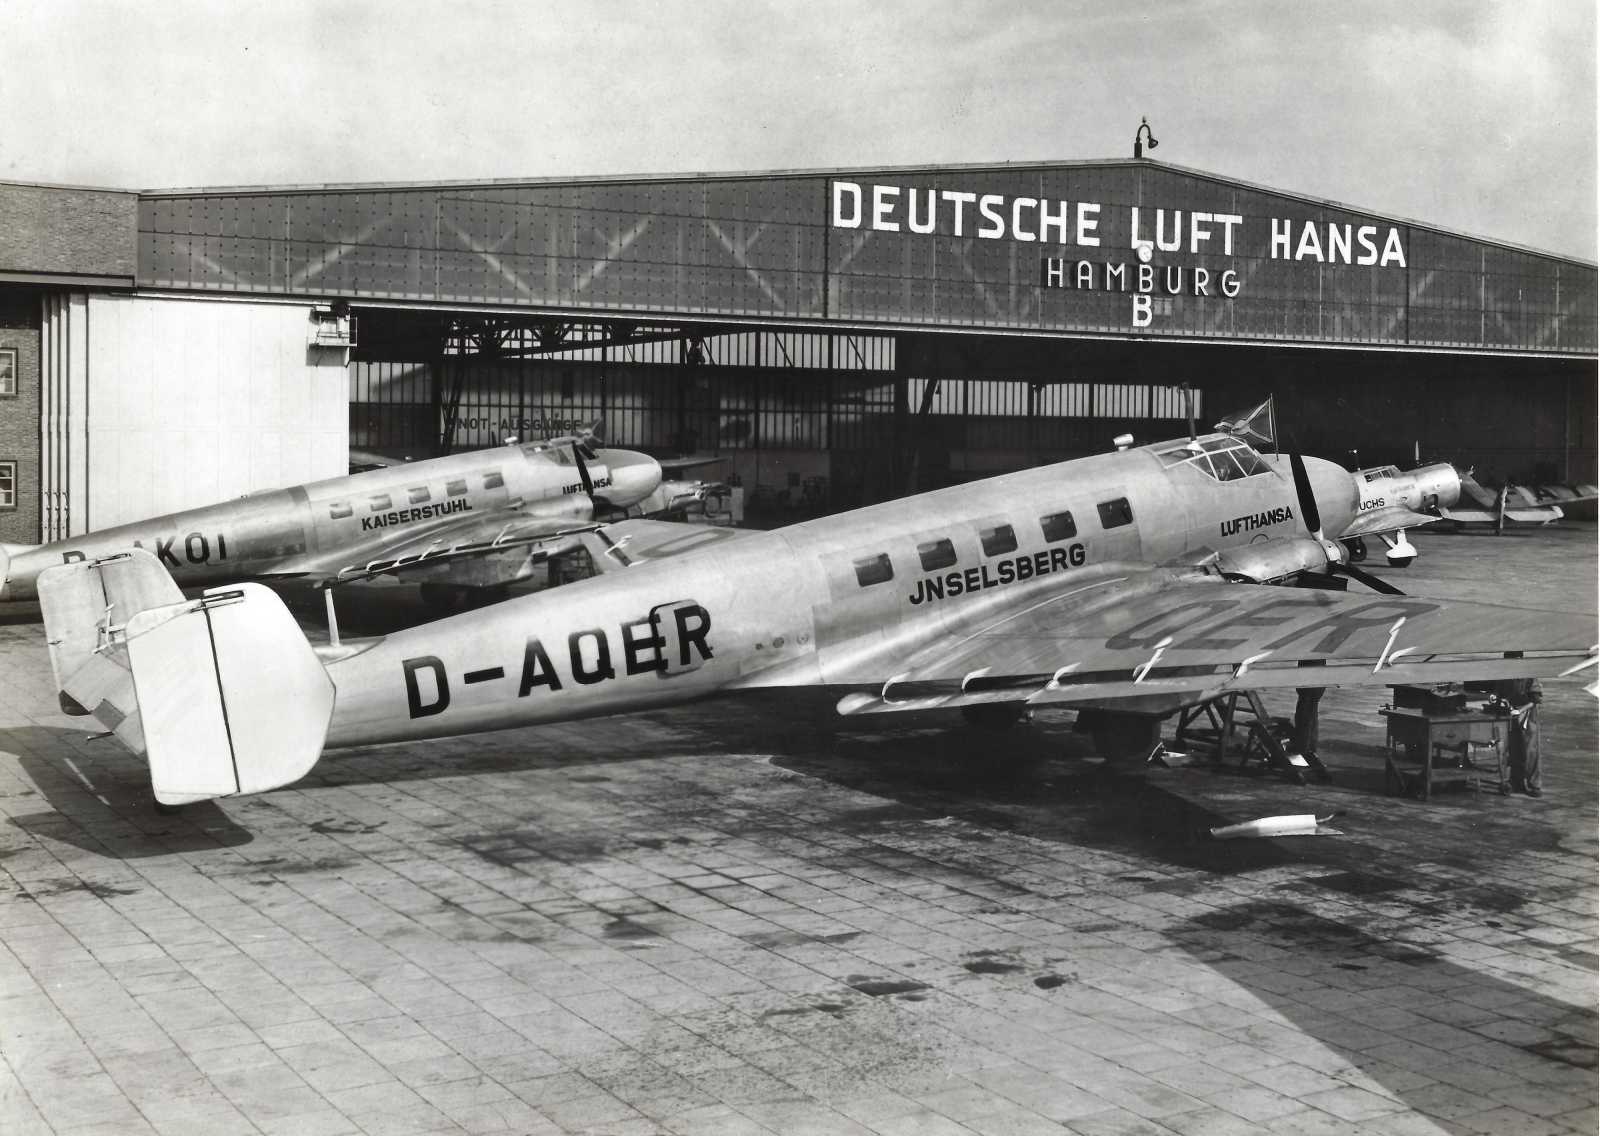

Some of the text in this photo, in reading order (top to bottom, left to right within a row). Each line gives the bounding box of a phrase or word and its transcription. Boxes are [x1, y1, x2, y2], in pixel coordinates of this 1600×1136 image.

[833, 181, 1407, 267] DEUTSCHE LUFT HANSA
[1047, 257, 1241, 298] HAMBURG
[1132, 293, 1153, 327] B
[361, 498, 473, 531] KAISERSTUHL
[1220, 506, 1293, 537] LUFTHANSA
[909, 543, 1086, 605] JNSELSBERG
